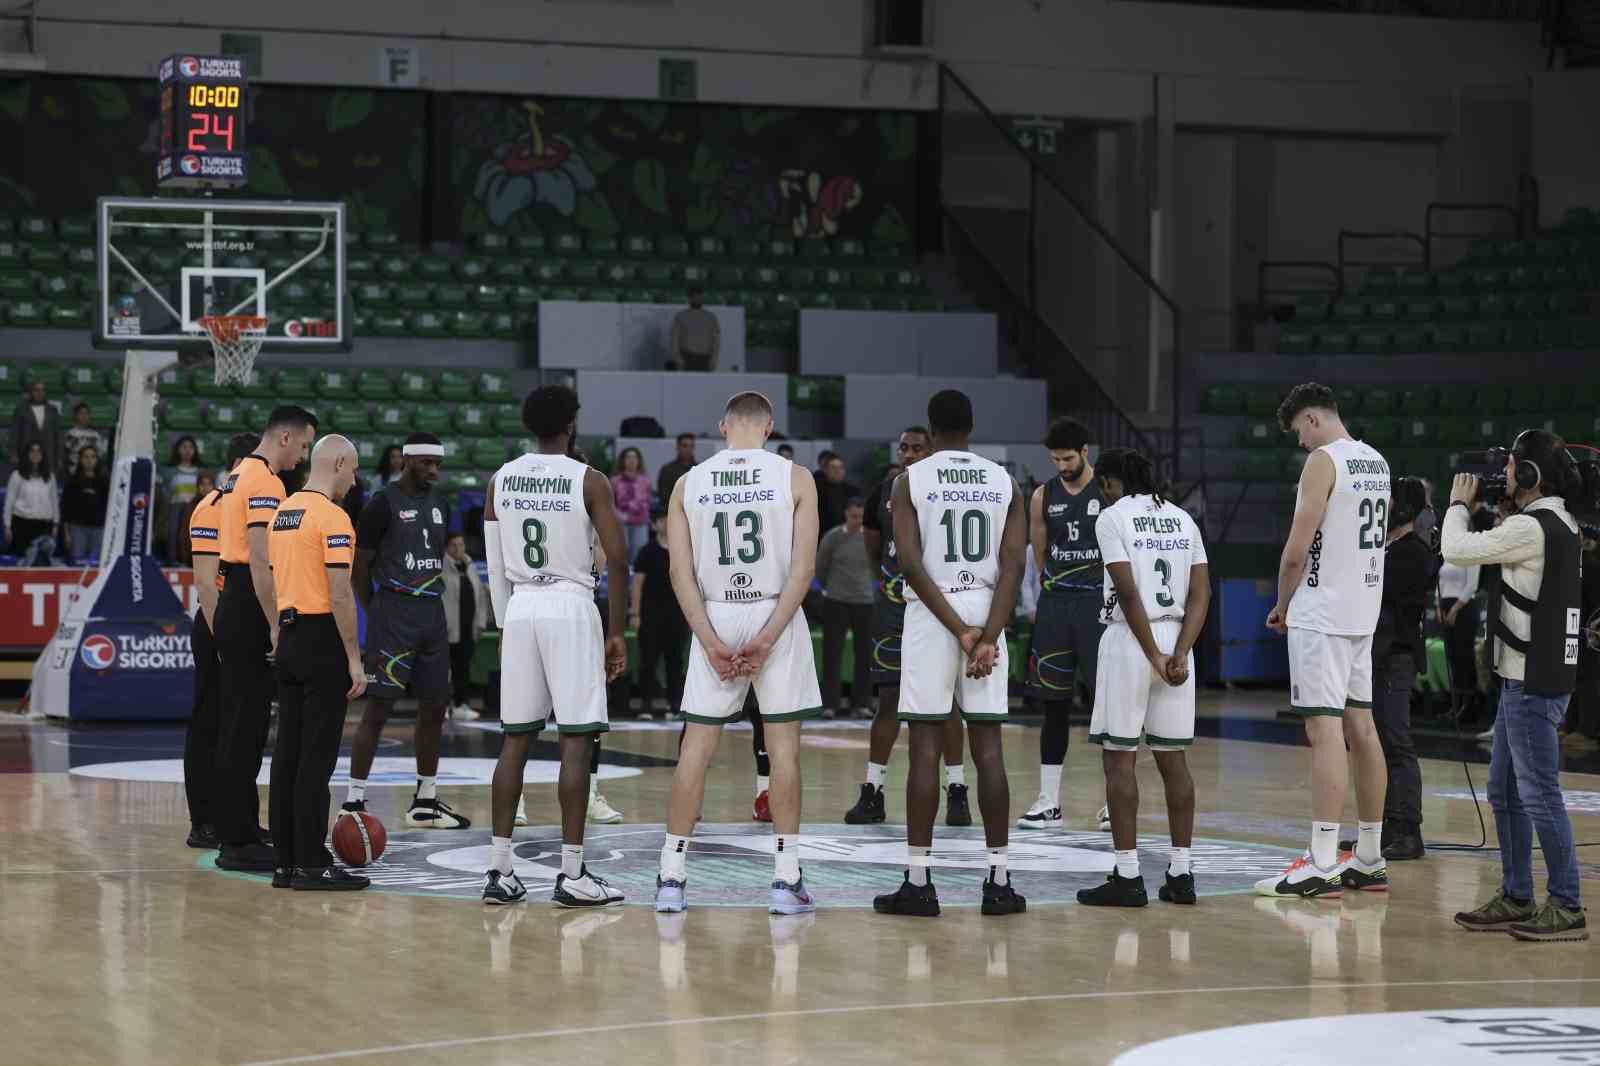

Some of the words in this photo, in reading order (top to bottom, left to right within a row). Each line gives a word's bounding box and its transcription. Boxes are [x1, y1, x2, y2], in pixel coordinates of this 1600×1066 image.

[189, 85, 240, 108] 10:00
[188, 112, 234, 152] 24
[937, 468, 987, 484] MOORE
[514, 499, 571, 512] BORLEASE
[714, 490, 774, 505] BORLEASE
[943, 490, 1002, 503] BORLEASE
[1359, 498, 1387, 549] 23
[523, 518, 546, 569] 8
[712, 510, 765, 565] 13
[940, 509, 990, 563] 10
[1059, 549, 1098, 560] PETKIM
[1154, 558, 1172, 607] 3
[724, 589, 762, 602] Hilton
